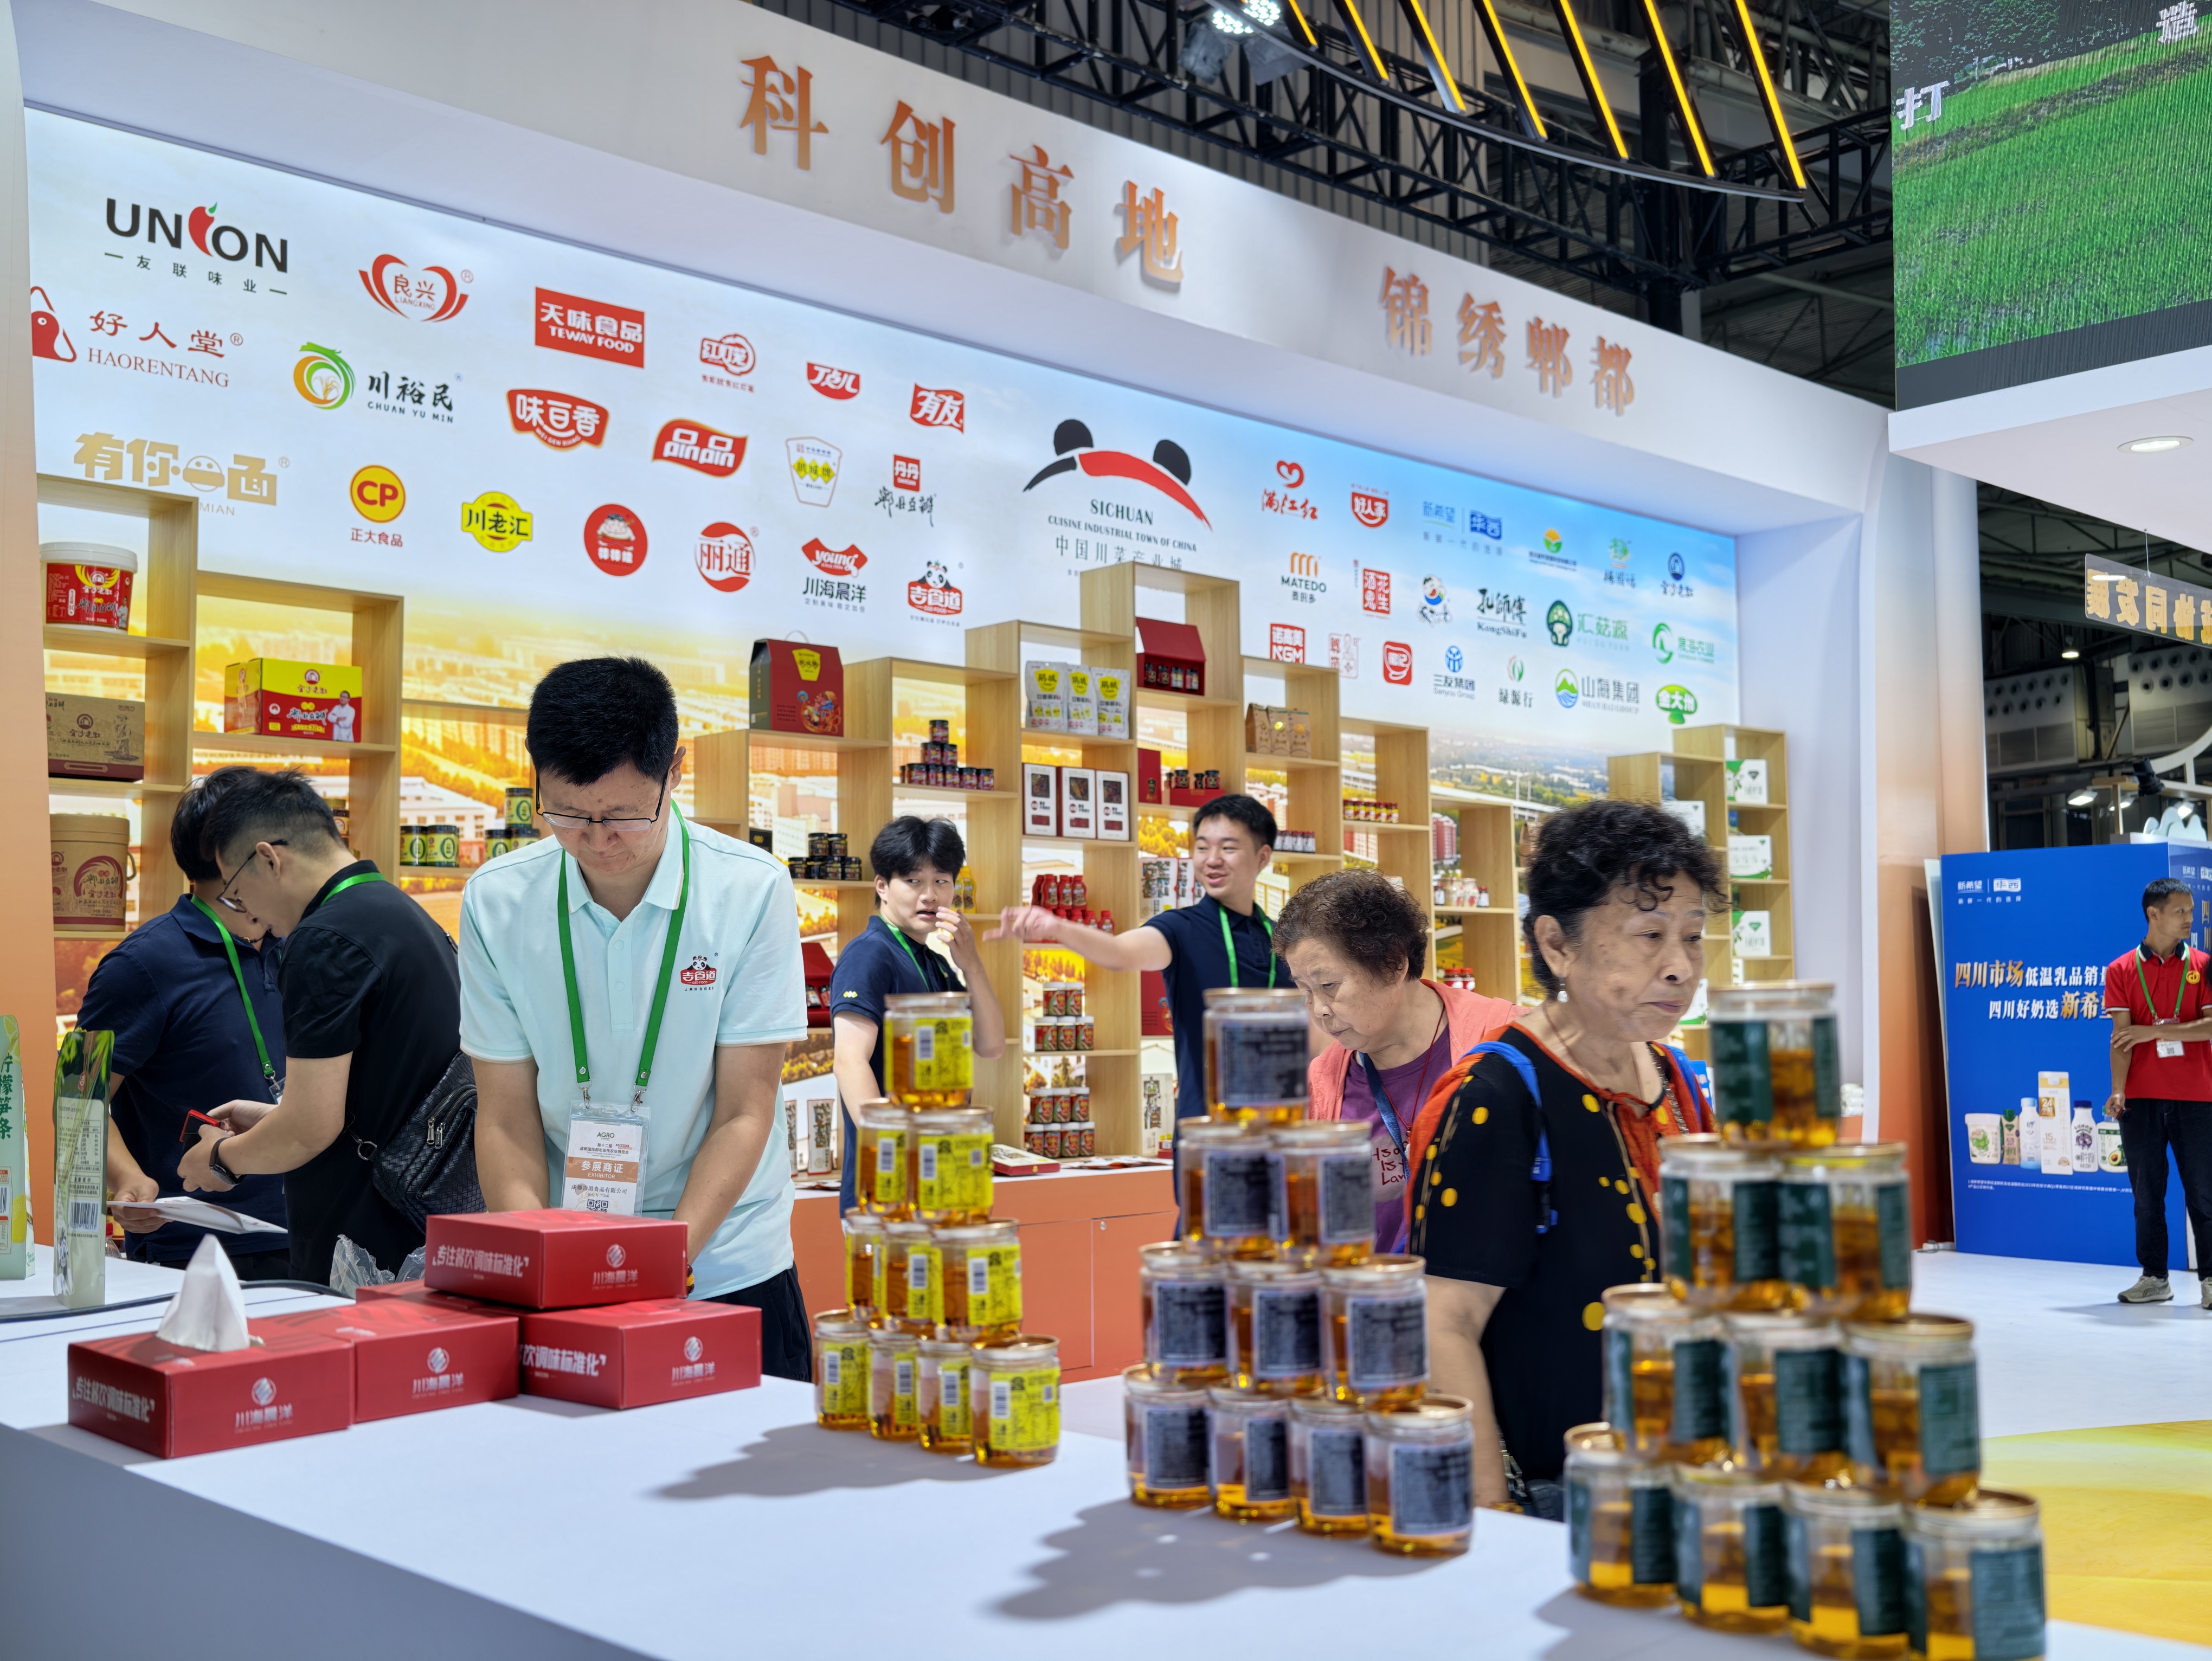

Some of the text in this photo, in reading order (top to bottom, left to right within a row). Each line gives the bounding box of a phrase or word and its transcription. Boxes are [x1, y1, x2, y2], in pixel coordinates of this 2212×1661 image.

[2157, 1, 2198, 44] 造
[1896, 81, 1950, 131] 打
[740, 55, 1635, 416] 科创高地 锦绣郫都
[137, 255, 256, 293] 友联味业
[394, 274, 435, 302] 良兴
[395, 295, 436, 311] LIANGXING
[89, 311, 226, 358] 好人堂
[541, 301, 642, 343] 天味食品
[549, 326, 634, 353] TEWAY FOOD
[88, 347, 229, 388] HAORENTANG
[368, 371, 453, 411] 川裕民
[368, 402, 454, 423] CHUAN YU MIN
[357, 480, 399, 507] CP
[466, 509, 529, 536] 川老汇
[1090, 498, 1154, 525] SICHUAN
[350, 527, 403, 548] 正大食品
[1048, 515, 1197, 552] CUISINE INDUSTRIAL TOWN OF CHINA
[803, 577, 866, 603] 川海晨洋
[1281, 575, 1327, 593] MATEDO
[1578, 613, 1628, 640] 汇菇源
[1581, 676, 1640, 705] 山海集团
[682, 970, 716, 982] 吉食道
[580, 1147, 629, 1155] 成都国际都市现代农业博览会
[581, 1160, 623, 1174] 参展商证
[592, 1269, 638, 1286] 川海晨洋
